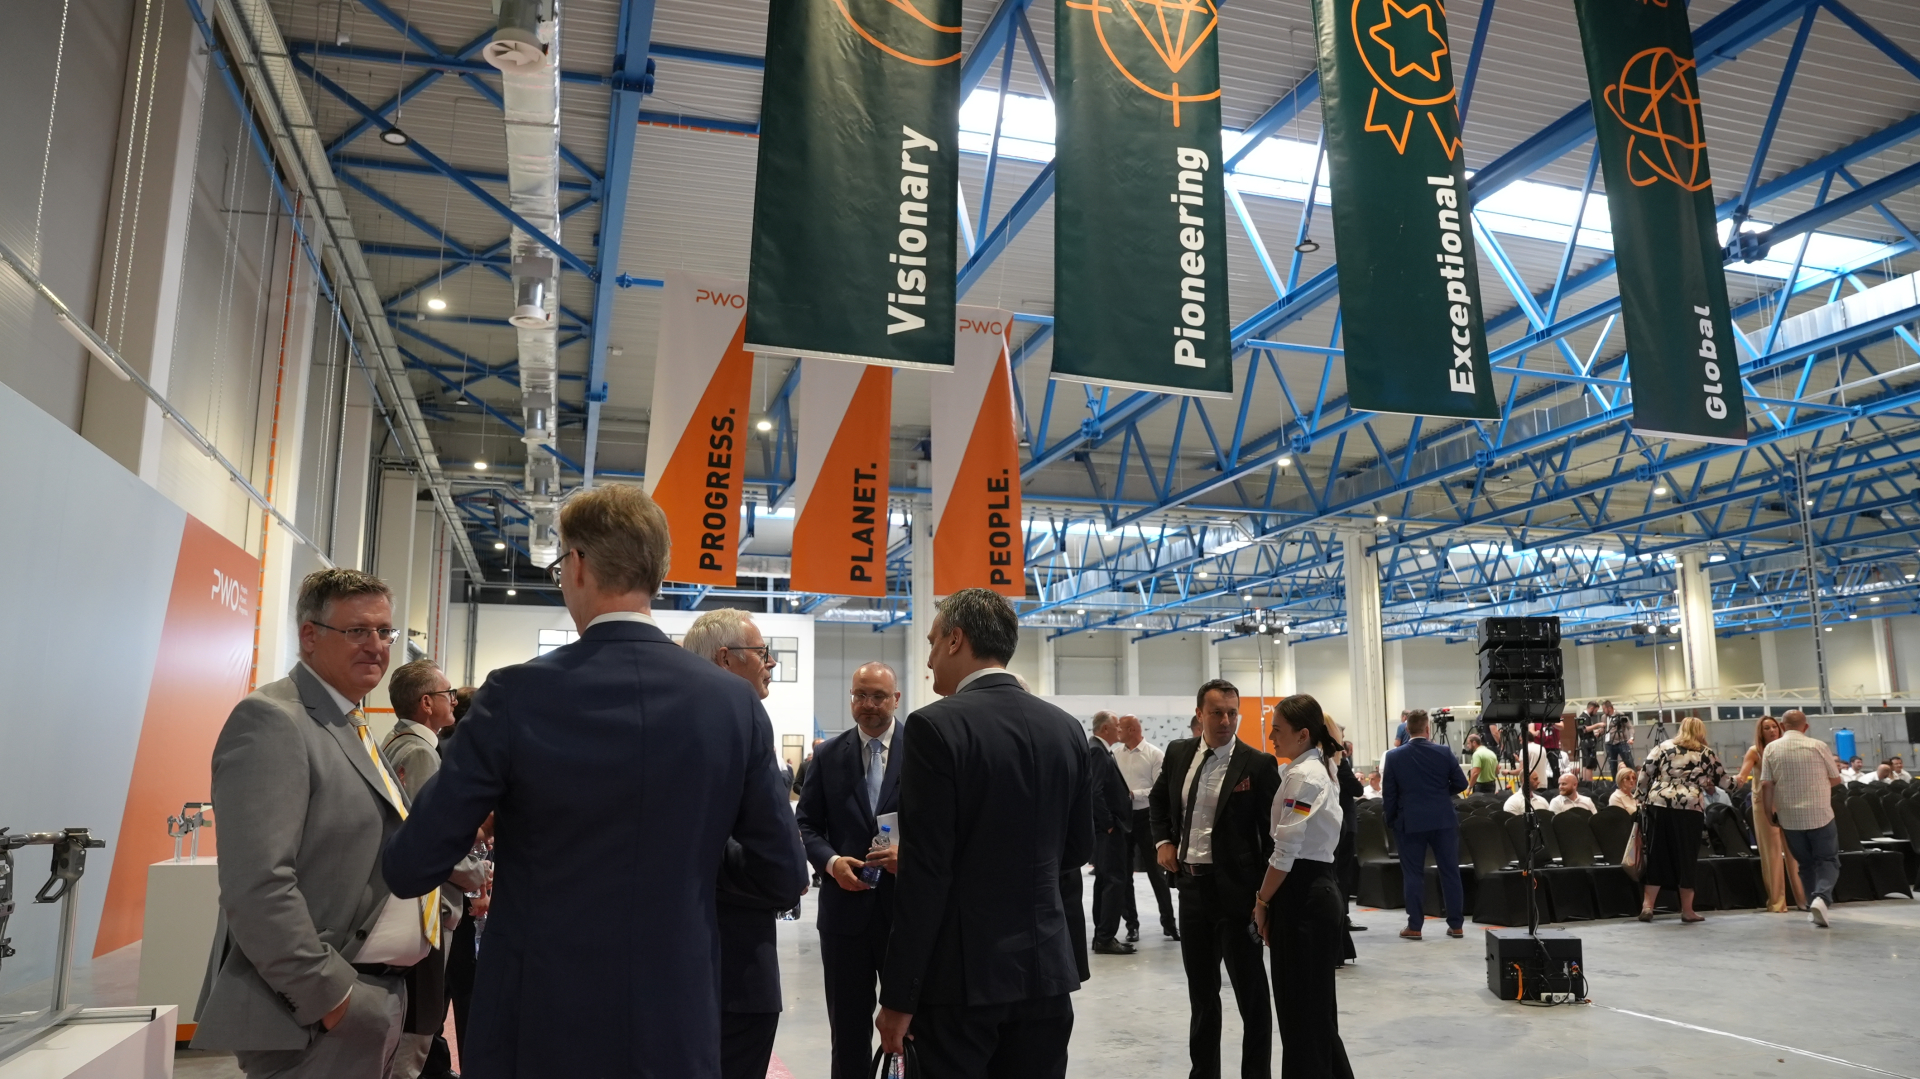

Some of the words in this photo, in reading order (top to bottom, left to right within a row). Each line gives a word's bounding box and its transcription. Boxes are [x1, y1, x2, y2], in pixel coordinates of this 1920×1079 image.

[887, 125, 939, 334] Visionary
[1171, 147, 1209, 368] Pioneering
[1428, 174, 1476, 394] Exceptional
[696, 289, 745, 309] PWO
[959, 318, 1003, 336] PWO
[1693, 305, 1728, 420] Global
[700, 407, 736, 571] PROGRESS.
[850, 462, 877, 583] PLANET.
[988, 468, 1011, 585] PEOPLE.
[211, 568, 240, 611] PWO
